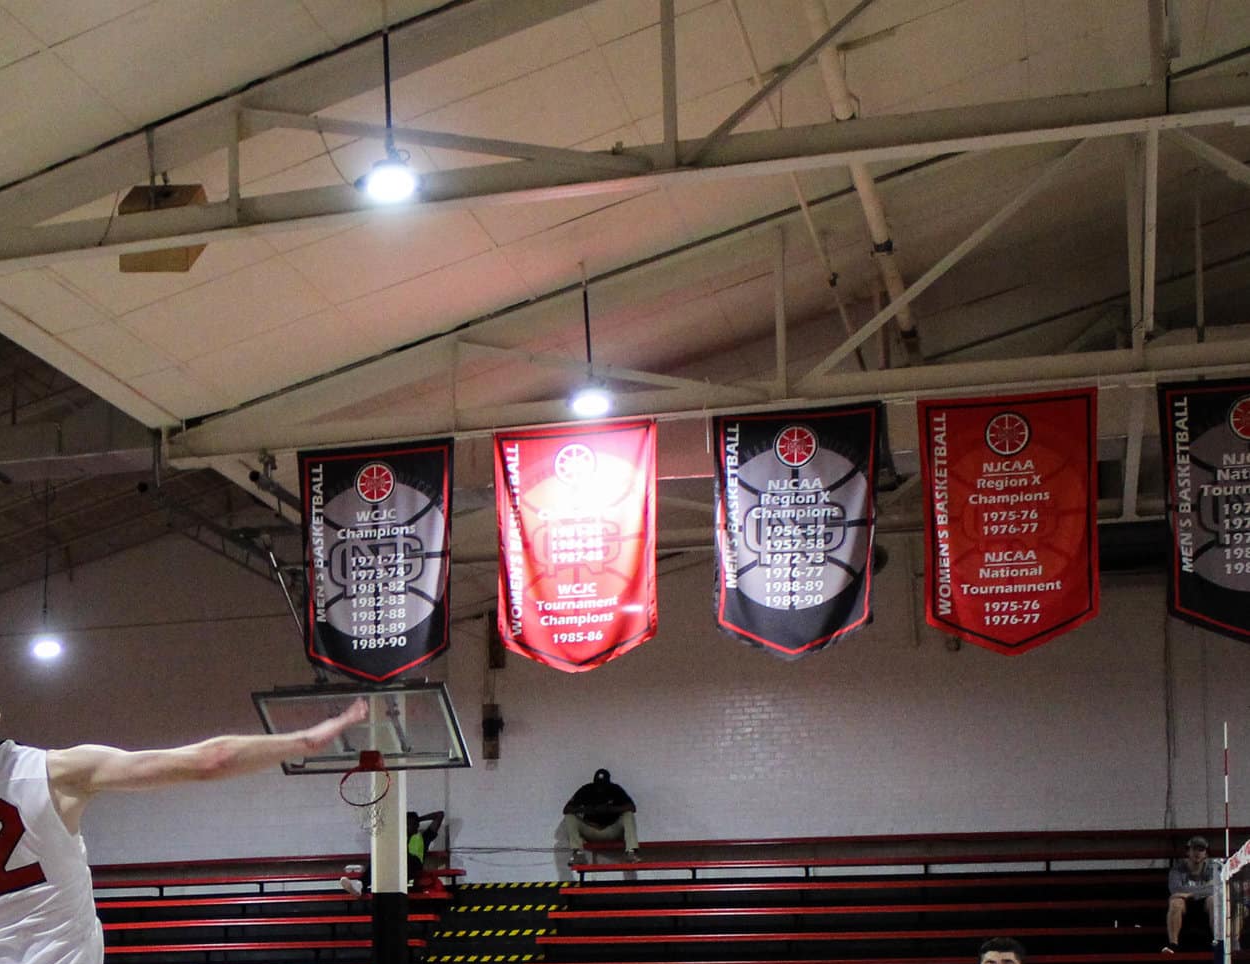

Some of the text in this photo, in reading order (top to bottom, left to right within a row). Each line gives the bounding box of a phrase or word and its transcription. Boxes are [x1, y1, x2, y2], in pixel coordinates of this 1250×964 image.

[1175, 397, 1191, 512] BASKETBALL
[982, 459, 1035, 473] NJCAA
[726, 424, 739, 532] BASKETBALL
[767, 478, 823, 490] NJCAA
[977, 475, 1041, 490] Region X
[760, 491, 830, 507] Region X
[968, 490, 1050, 505] Champions
[311, 464, 324, 568] BASKETBALL
[356, 509, 397, 522] WCJC
[751, 505, 839, 521] Champions
[934, 412, 951, 615] WOMEN'S BASKETBALL
[982, 510, 1038, 522] 1975-76
[337, 524, 416, 540] Champions
[766, 524, 825, 537] 1956-57
[982, 523, 1038, 535] 1976-77
[766, 538, 825, 551] 1957-58
[351, 553, 405, 567] 1971-72
[765, 552, 825, 564] 1972-73
[984, 550, 1037, 563] NJCAA
[351, 567, 405, 580] 1973-74
[765, 566, 824, 579] 1976-77
[979, 565, 1042, 579] National
[351, 580, 405, 594] 1981-82
[557, 583, 597, 595] WCJC
[765, 580, 824, 593] 1988-89
[351, 594, 406, 608] 1982-83
[536, 596, 618, 611] Tournament
[765, 594, 824, 607] 1989-90
[984, 600, 1040, 612] 1975-76
[352, 608, 406, 622] 1987-88
[540, 610, 614, 627] Champions
[984, 613, 1040, 626] 1976-77
[352, 622, 406, 635] 1988-89
[352, 636, 407, 650] 1989-90
[553, 630, 603, 643] 1985-86
